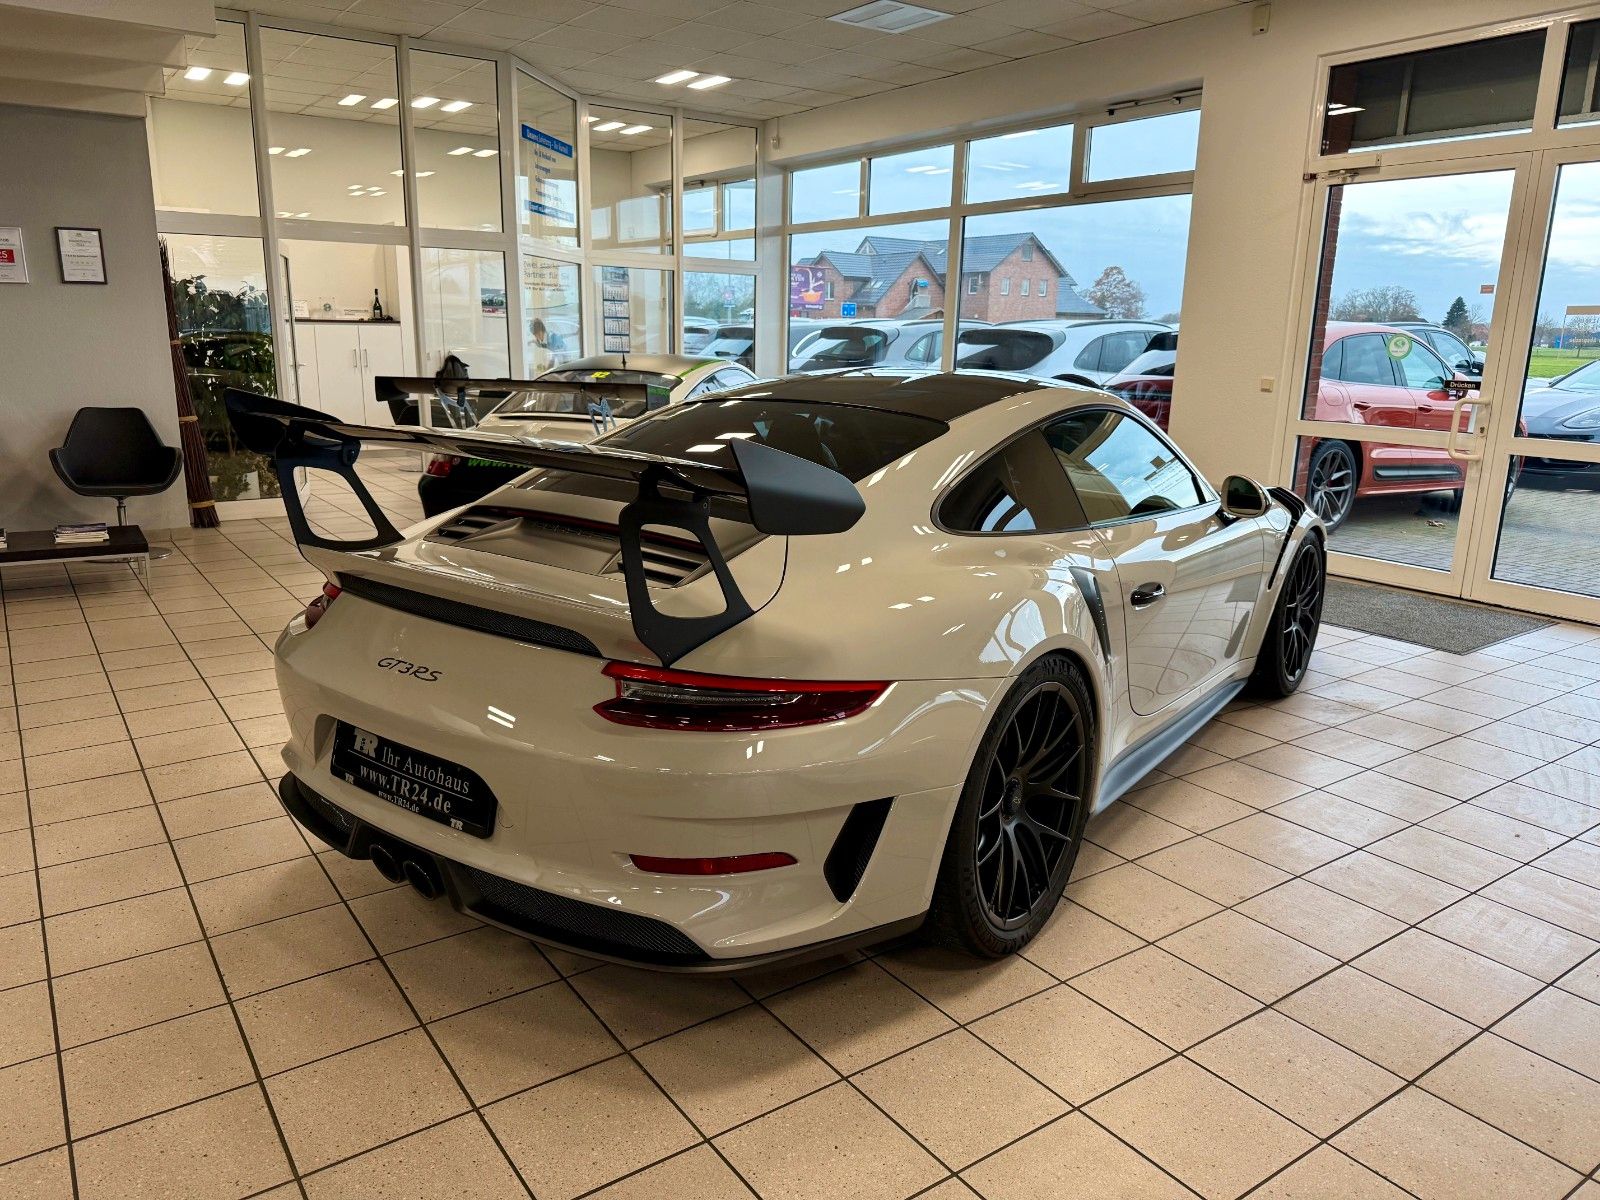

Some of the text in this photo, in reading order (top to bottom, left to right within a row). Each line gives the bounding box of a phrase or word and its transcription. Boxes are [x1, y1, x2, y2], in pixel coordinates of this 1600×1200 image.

[1450, 381, 1476, 389] Drücken
[381, 746, 470, 795] Ihr Autohaus
[360, 764, 452, 815] www.TR24.de
[378, 790, 420, 813] www.TR24.de
